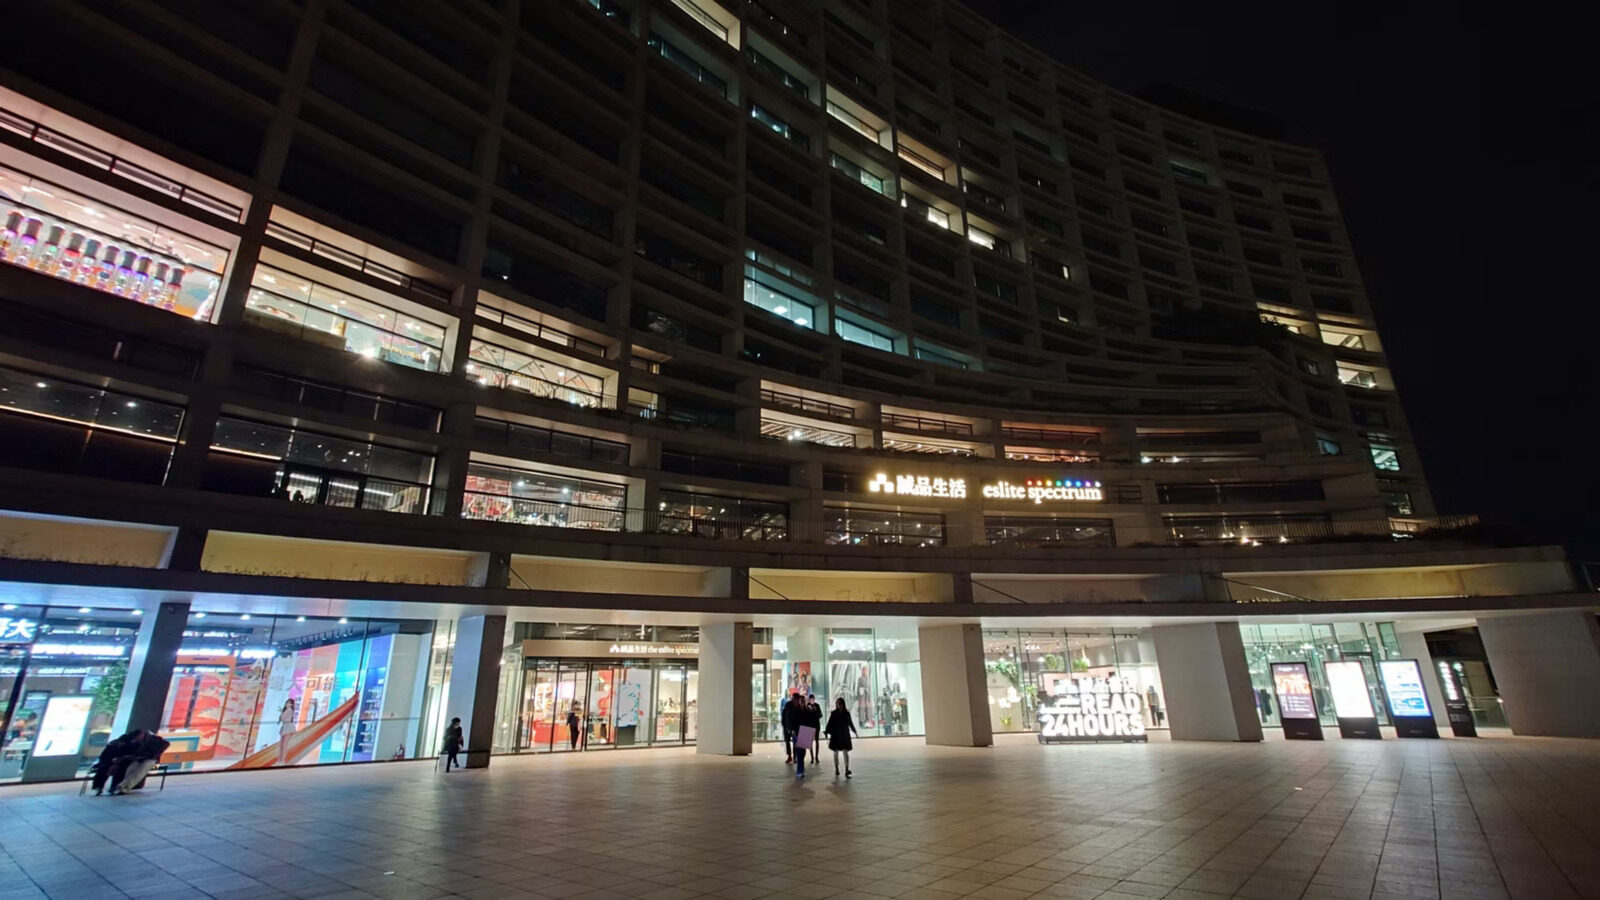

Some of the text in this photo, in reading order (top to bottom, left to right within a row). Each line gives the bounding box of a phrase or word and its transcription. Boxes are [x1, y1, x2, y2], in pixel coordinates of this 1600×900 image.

[896, 475, 967, 499] 誠品生活
[983, 481, 1102, 504] eslite spectrum
[1080, 693, 1141, 714] READ
